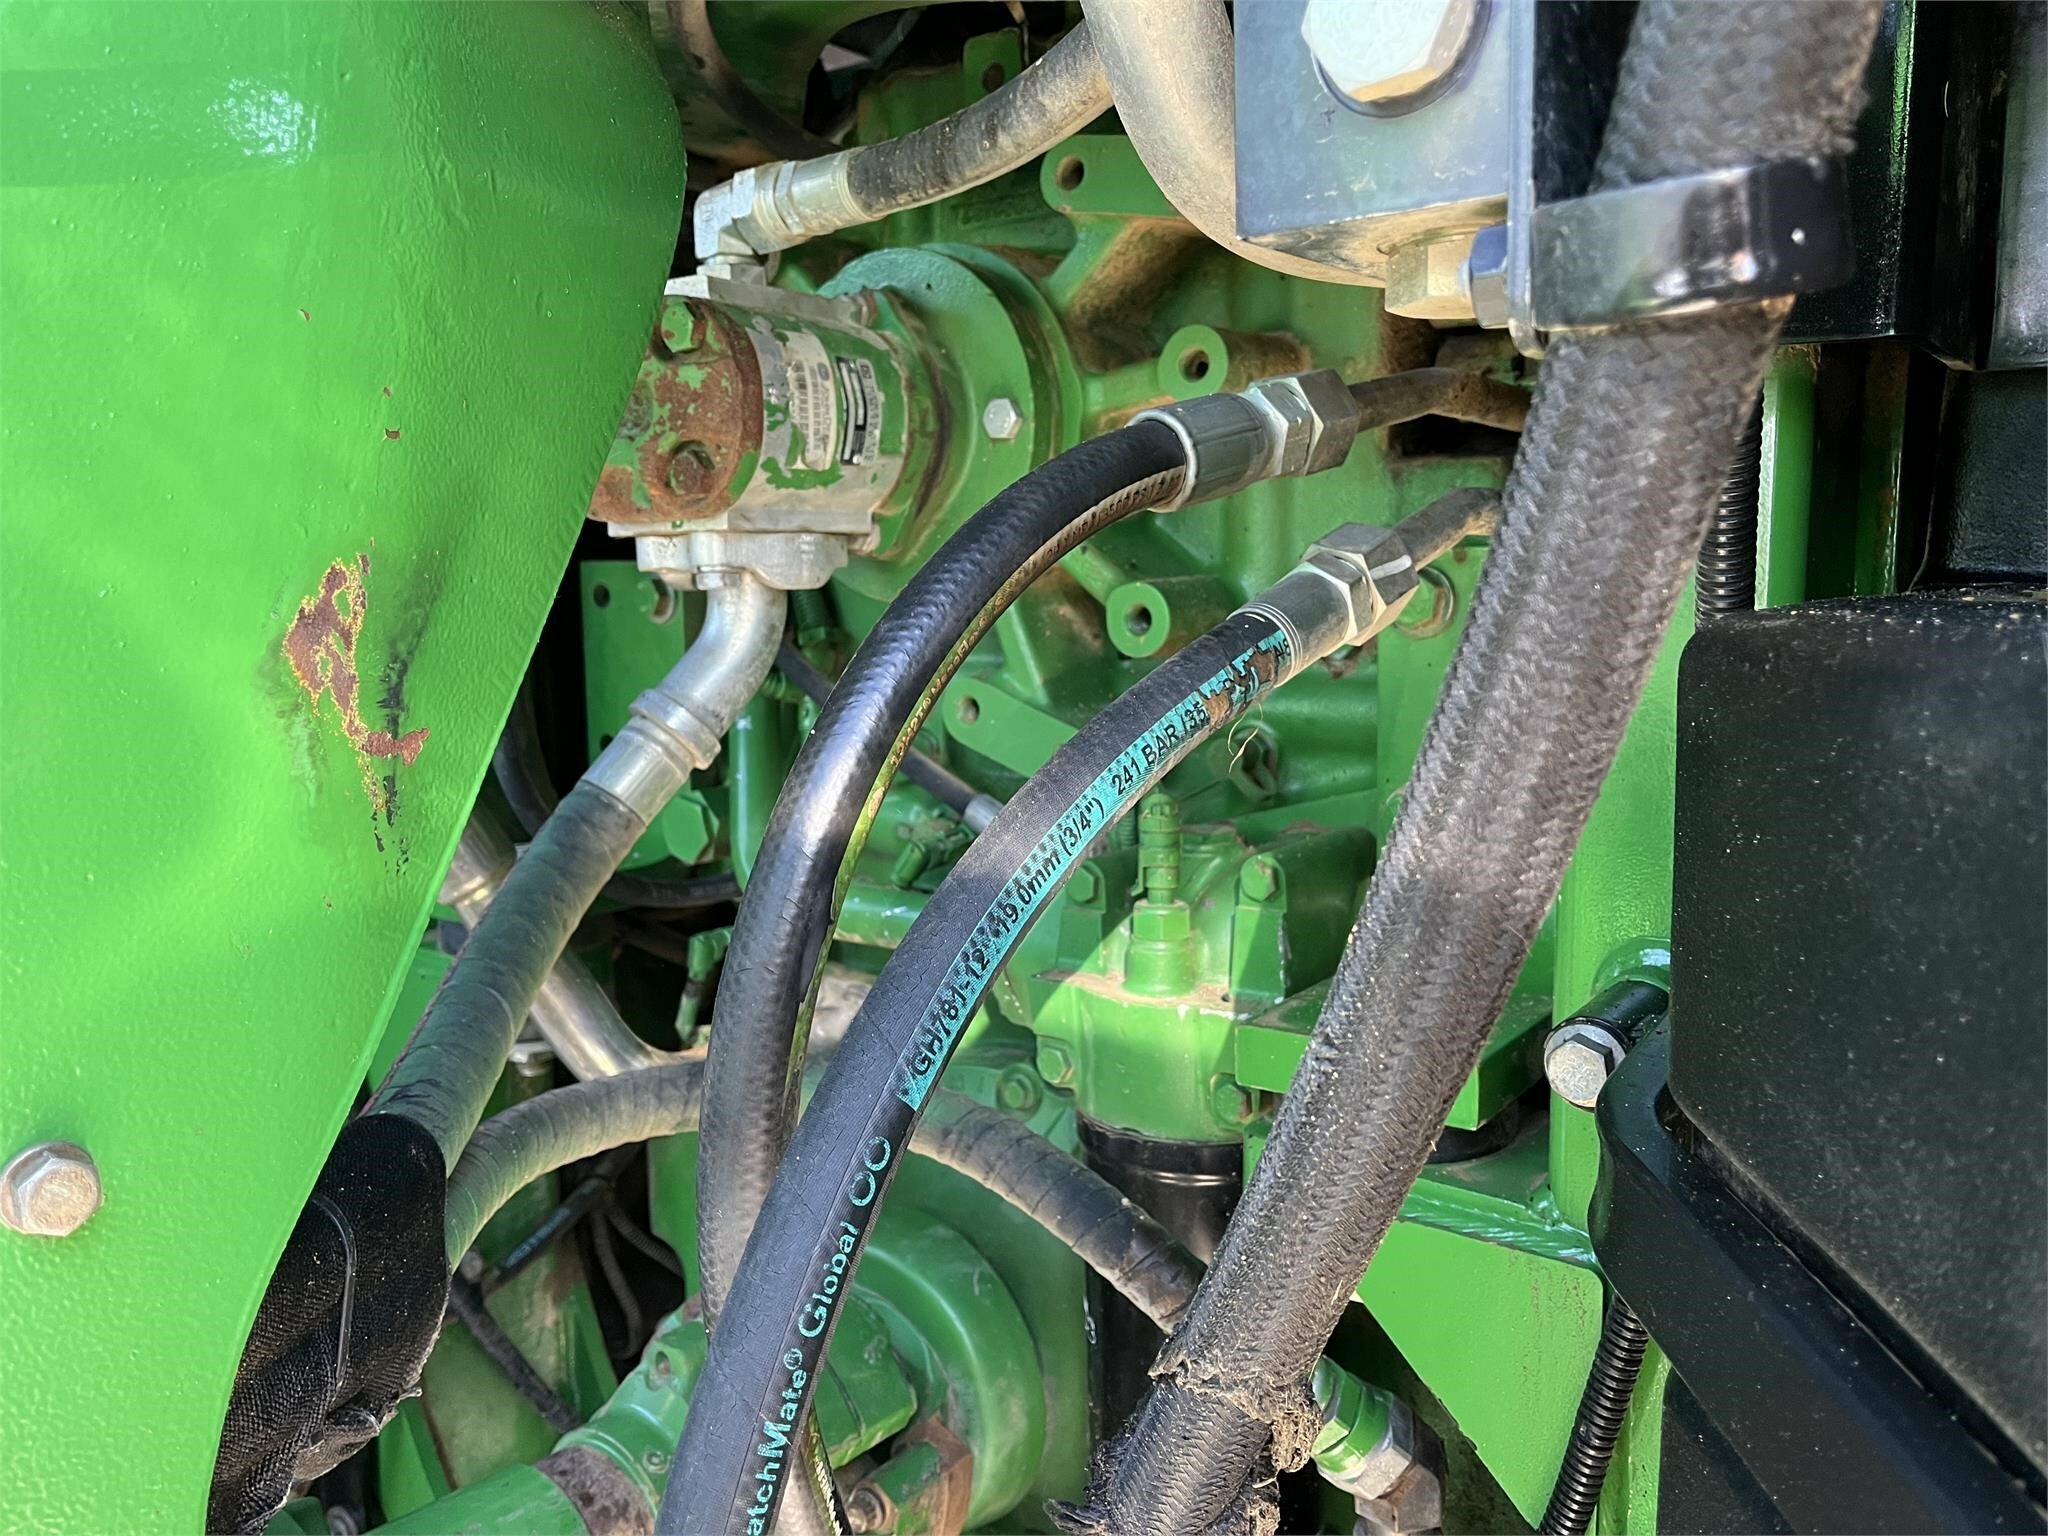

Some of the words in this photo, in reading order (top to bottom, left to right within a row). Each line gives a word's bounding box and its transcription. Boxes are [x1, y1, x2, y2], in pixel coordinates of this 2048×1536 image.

[907, 949, 990, 1078] GH781-12
[1112, 761, 1142, 796] 241
[1141, 724, 1179, 768] BAR
[1182, 699, 1211, 735] /35
[798, 1221, 860, 1338] Global
